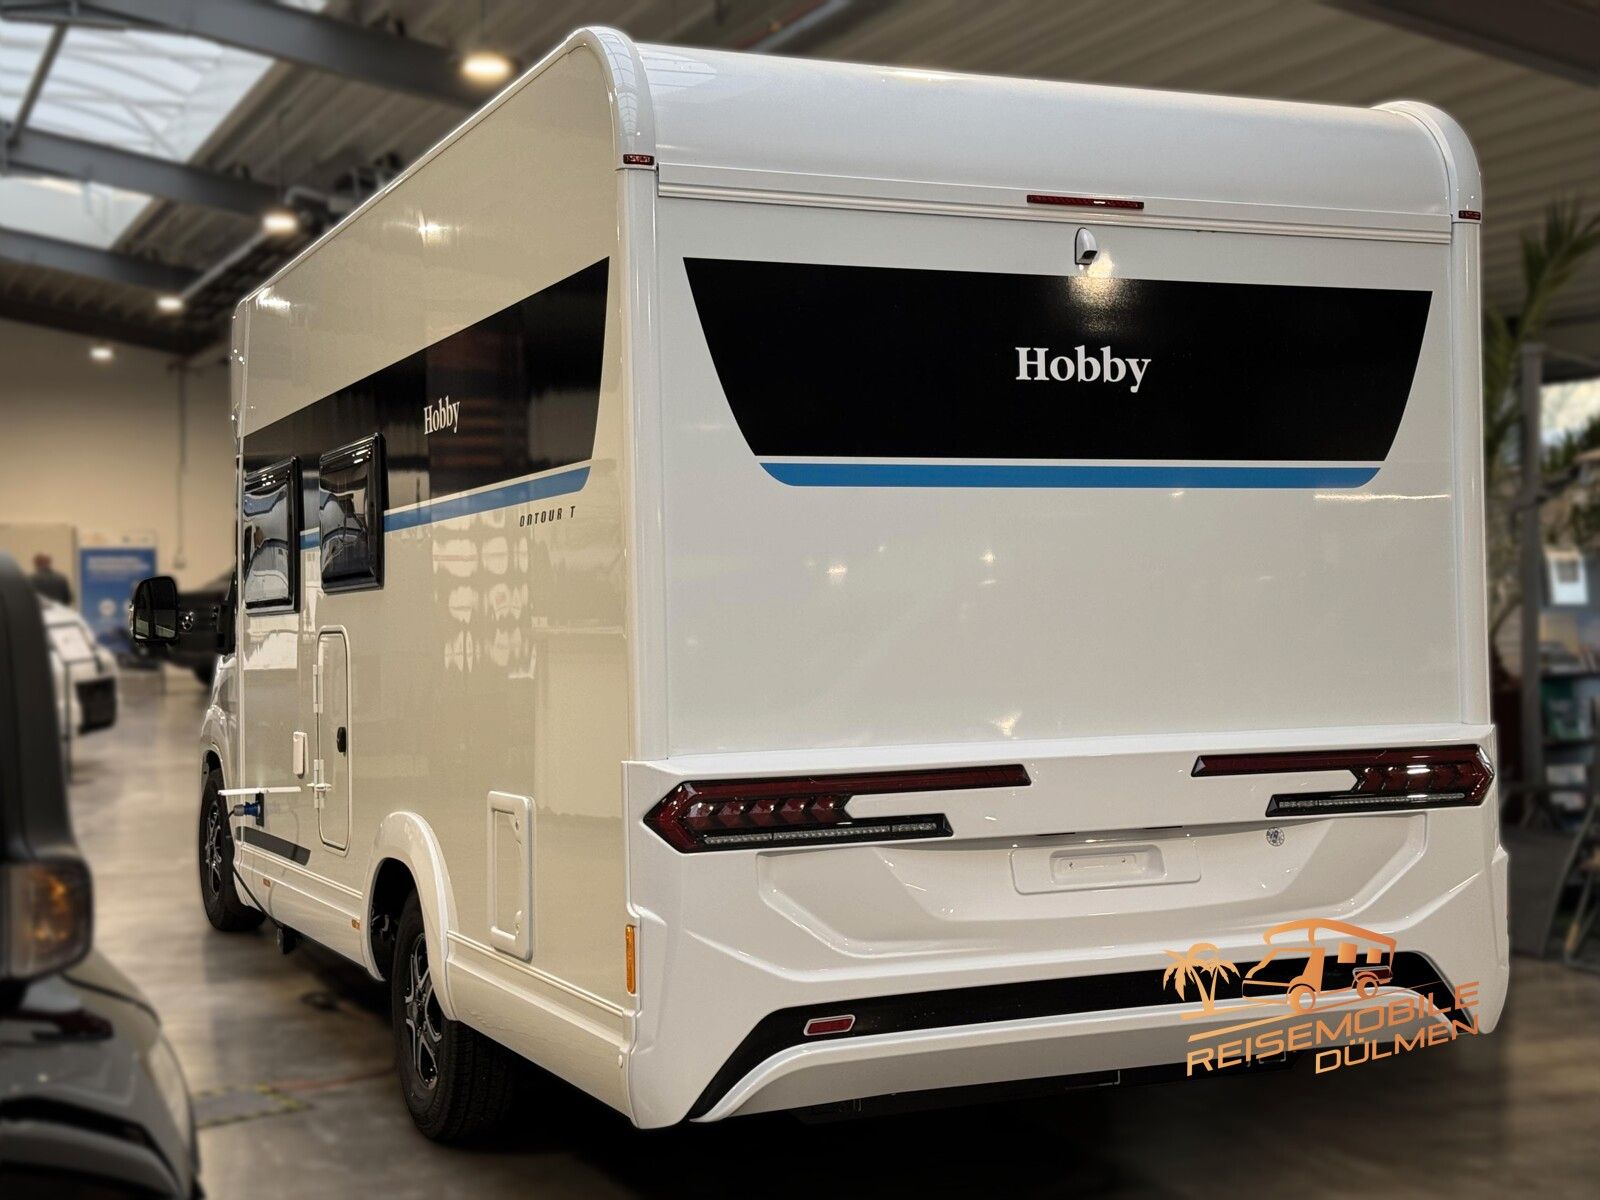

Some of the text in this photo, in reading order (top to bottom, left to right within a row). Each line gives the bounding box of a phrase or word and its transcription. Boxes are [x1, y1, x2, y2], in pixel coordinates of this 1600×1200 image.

[1015, 345, 1151, 393] Hobby
[424, 395, 460, 435] Hobby
[570, 505, 576, 518] T
